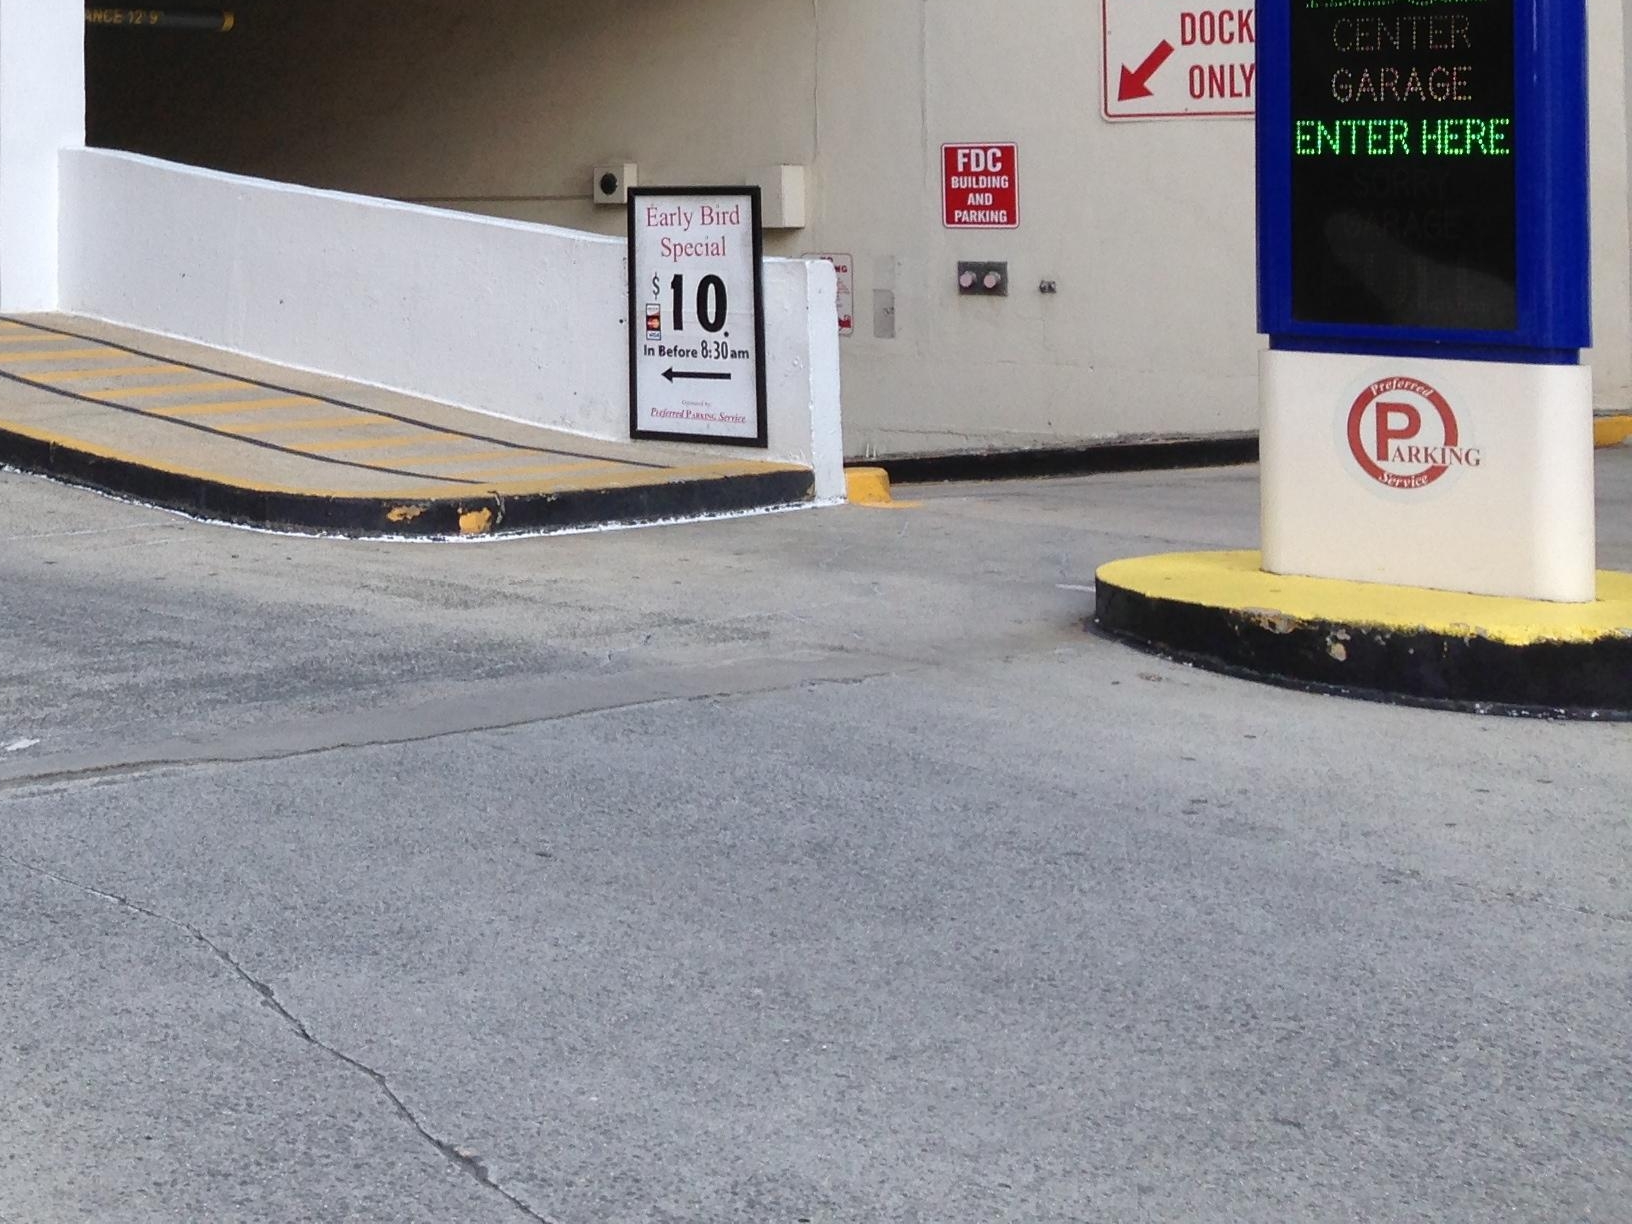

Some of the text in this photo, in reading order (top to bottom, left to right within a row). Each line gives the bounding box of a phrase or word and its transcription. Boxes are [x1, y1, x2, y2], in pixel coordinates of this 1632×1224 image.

[1180, 9, 1255, 46] DOCK
[1333, 15, 1472, 52] CENTER
[1188, 63, 1255, 99] ONLY
[1331, 66, 1473, 103] GARAGE
[1296, 118, 1511, 155] ENTER HERE
[956, 147, 1002, 172] FDC
[951, 176, 1009, 189] BUILDING
[967, 193, 993, 205] AND
[646, 204, 741, 231] Early Bird
[954, 209, 1008, 223] PARKING
[660, 235, 727, 263] Special
[643, 344, 655, 357] In
[658, 344, 698, 359] Before
[1369, 378, 1434, 398] Preferred
[1378, 471, 1430, 488] Service
